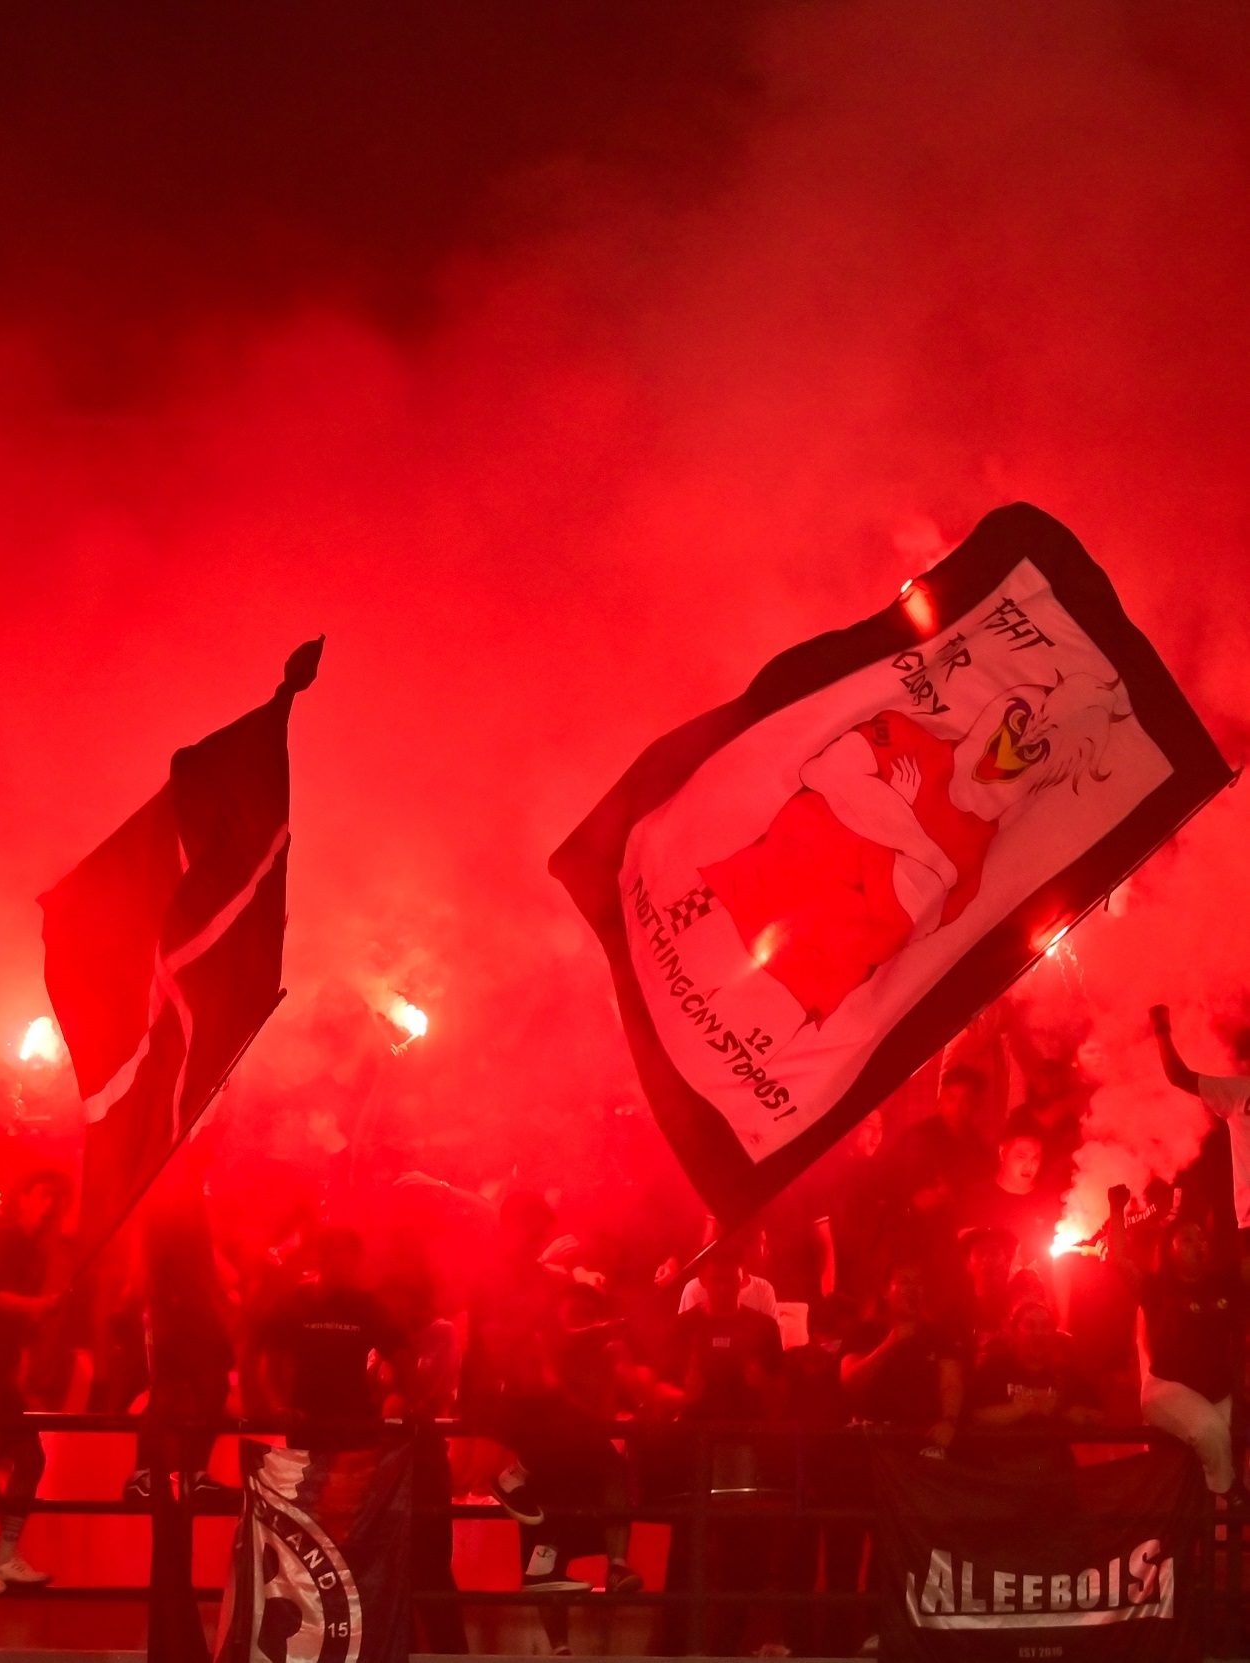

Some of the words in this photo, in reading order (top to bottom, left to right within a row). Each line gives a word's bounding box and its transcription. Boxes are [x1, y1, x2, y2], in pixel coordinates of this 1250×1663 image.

[935, 632, 971, 682] FR
[891, 652, 950, 715] GLORY
[745, 1027, 773, 1055] 12
[921, 1539, 1161, 1613] ALEEBOIS
[328, 1622, 349, 1639] 15
